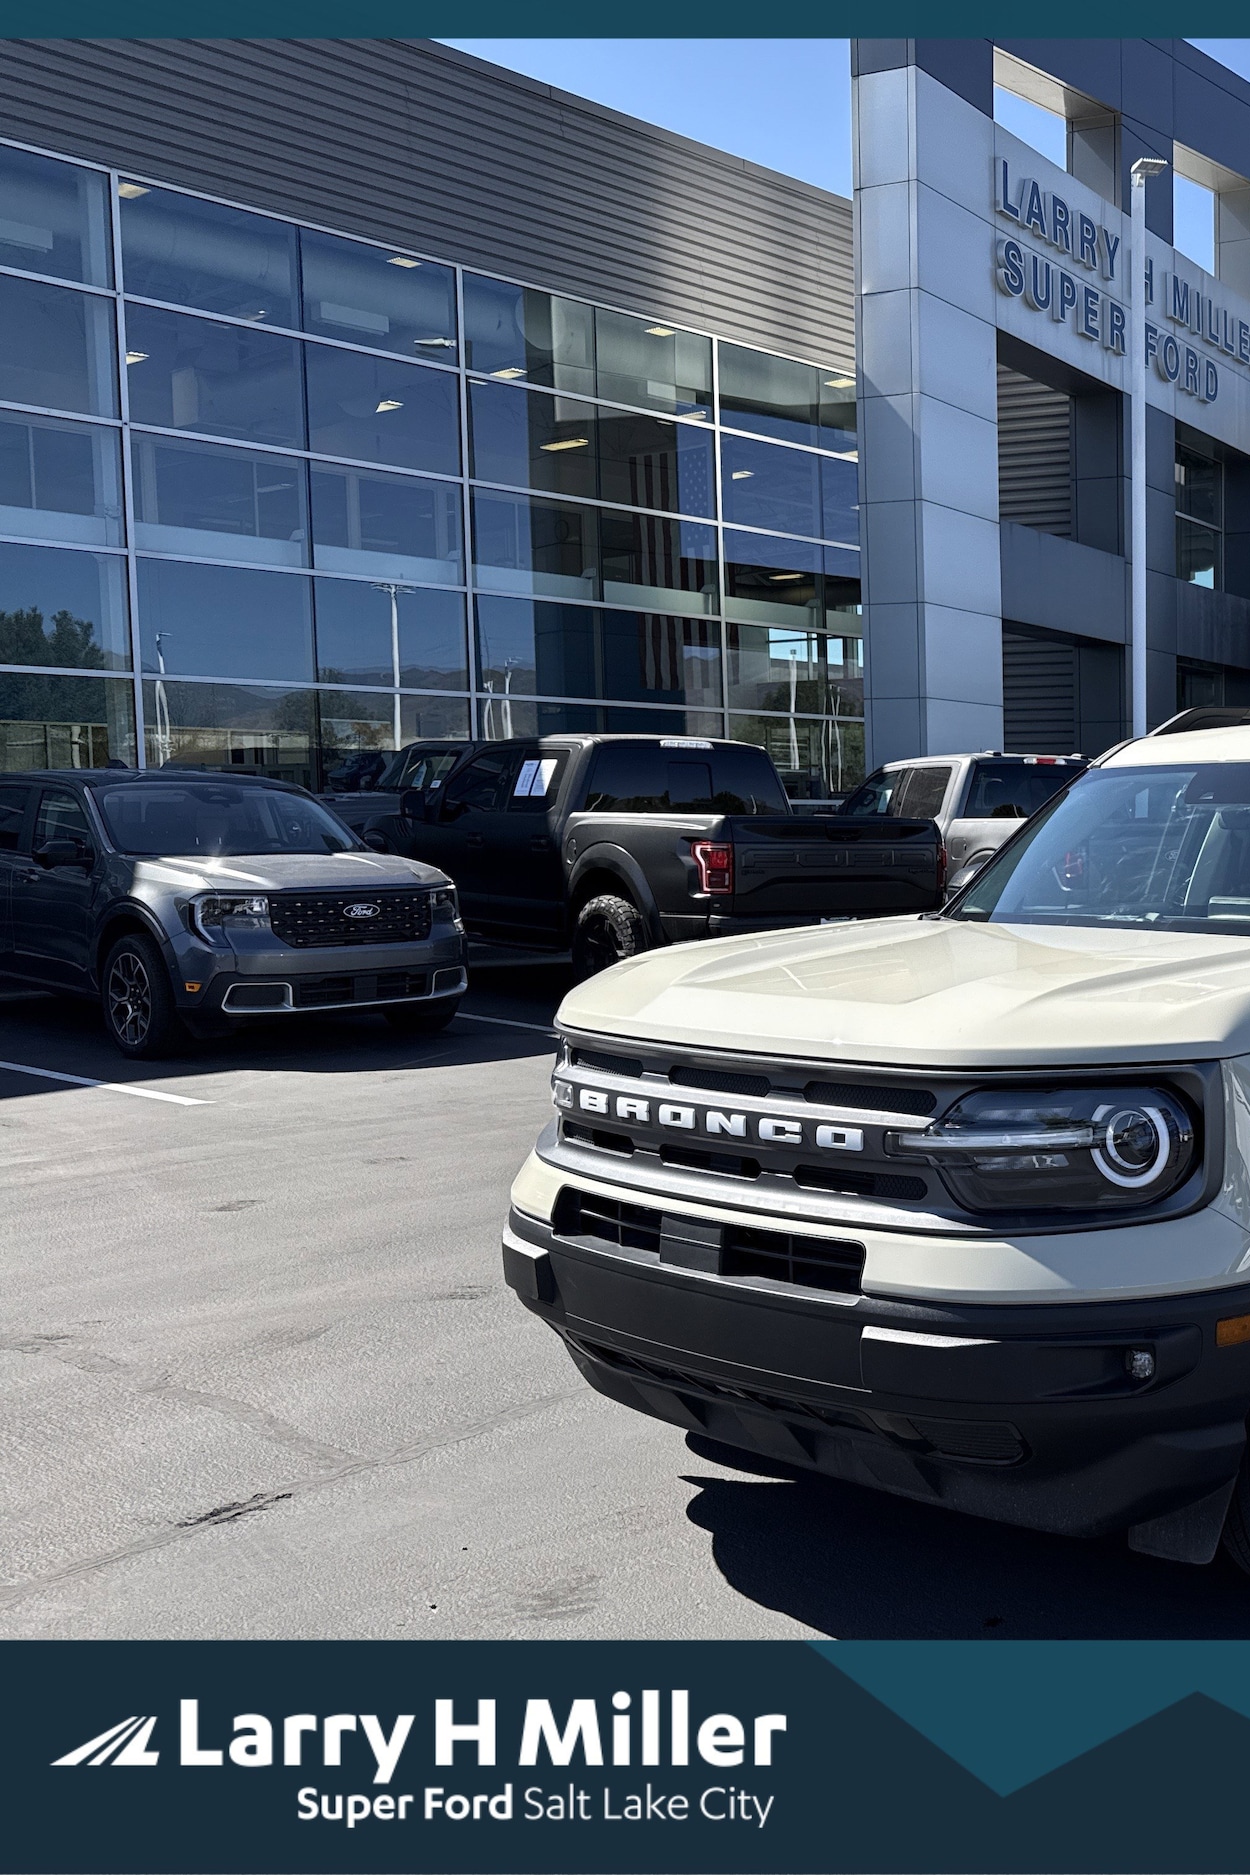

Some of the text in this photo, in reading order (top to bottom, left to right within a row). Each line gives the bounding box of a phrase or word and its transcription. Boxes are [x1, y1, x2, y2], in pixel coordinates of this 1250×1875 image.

[998, 156, 1120, 280] LARRY
[998, 239, 1218, 403] SUPER FORD
[350, 905, 374, 916] Ford
[579, 1088, 864, 1152] BRONCO
